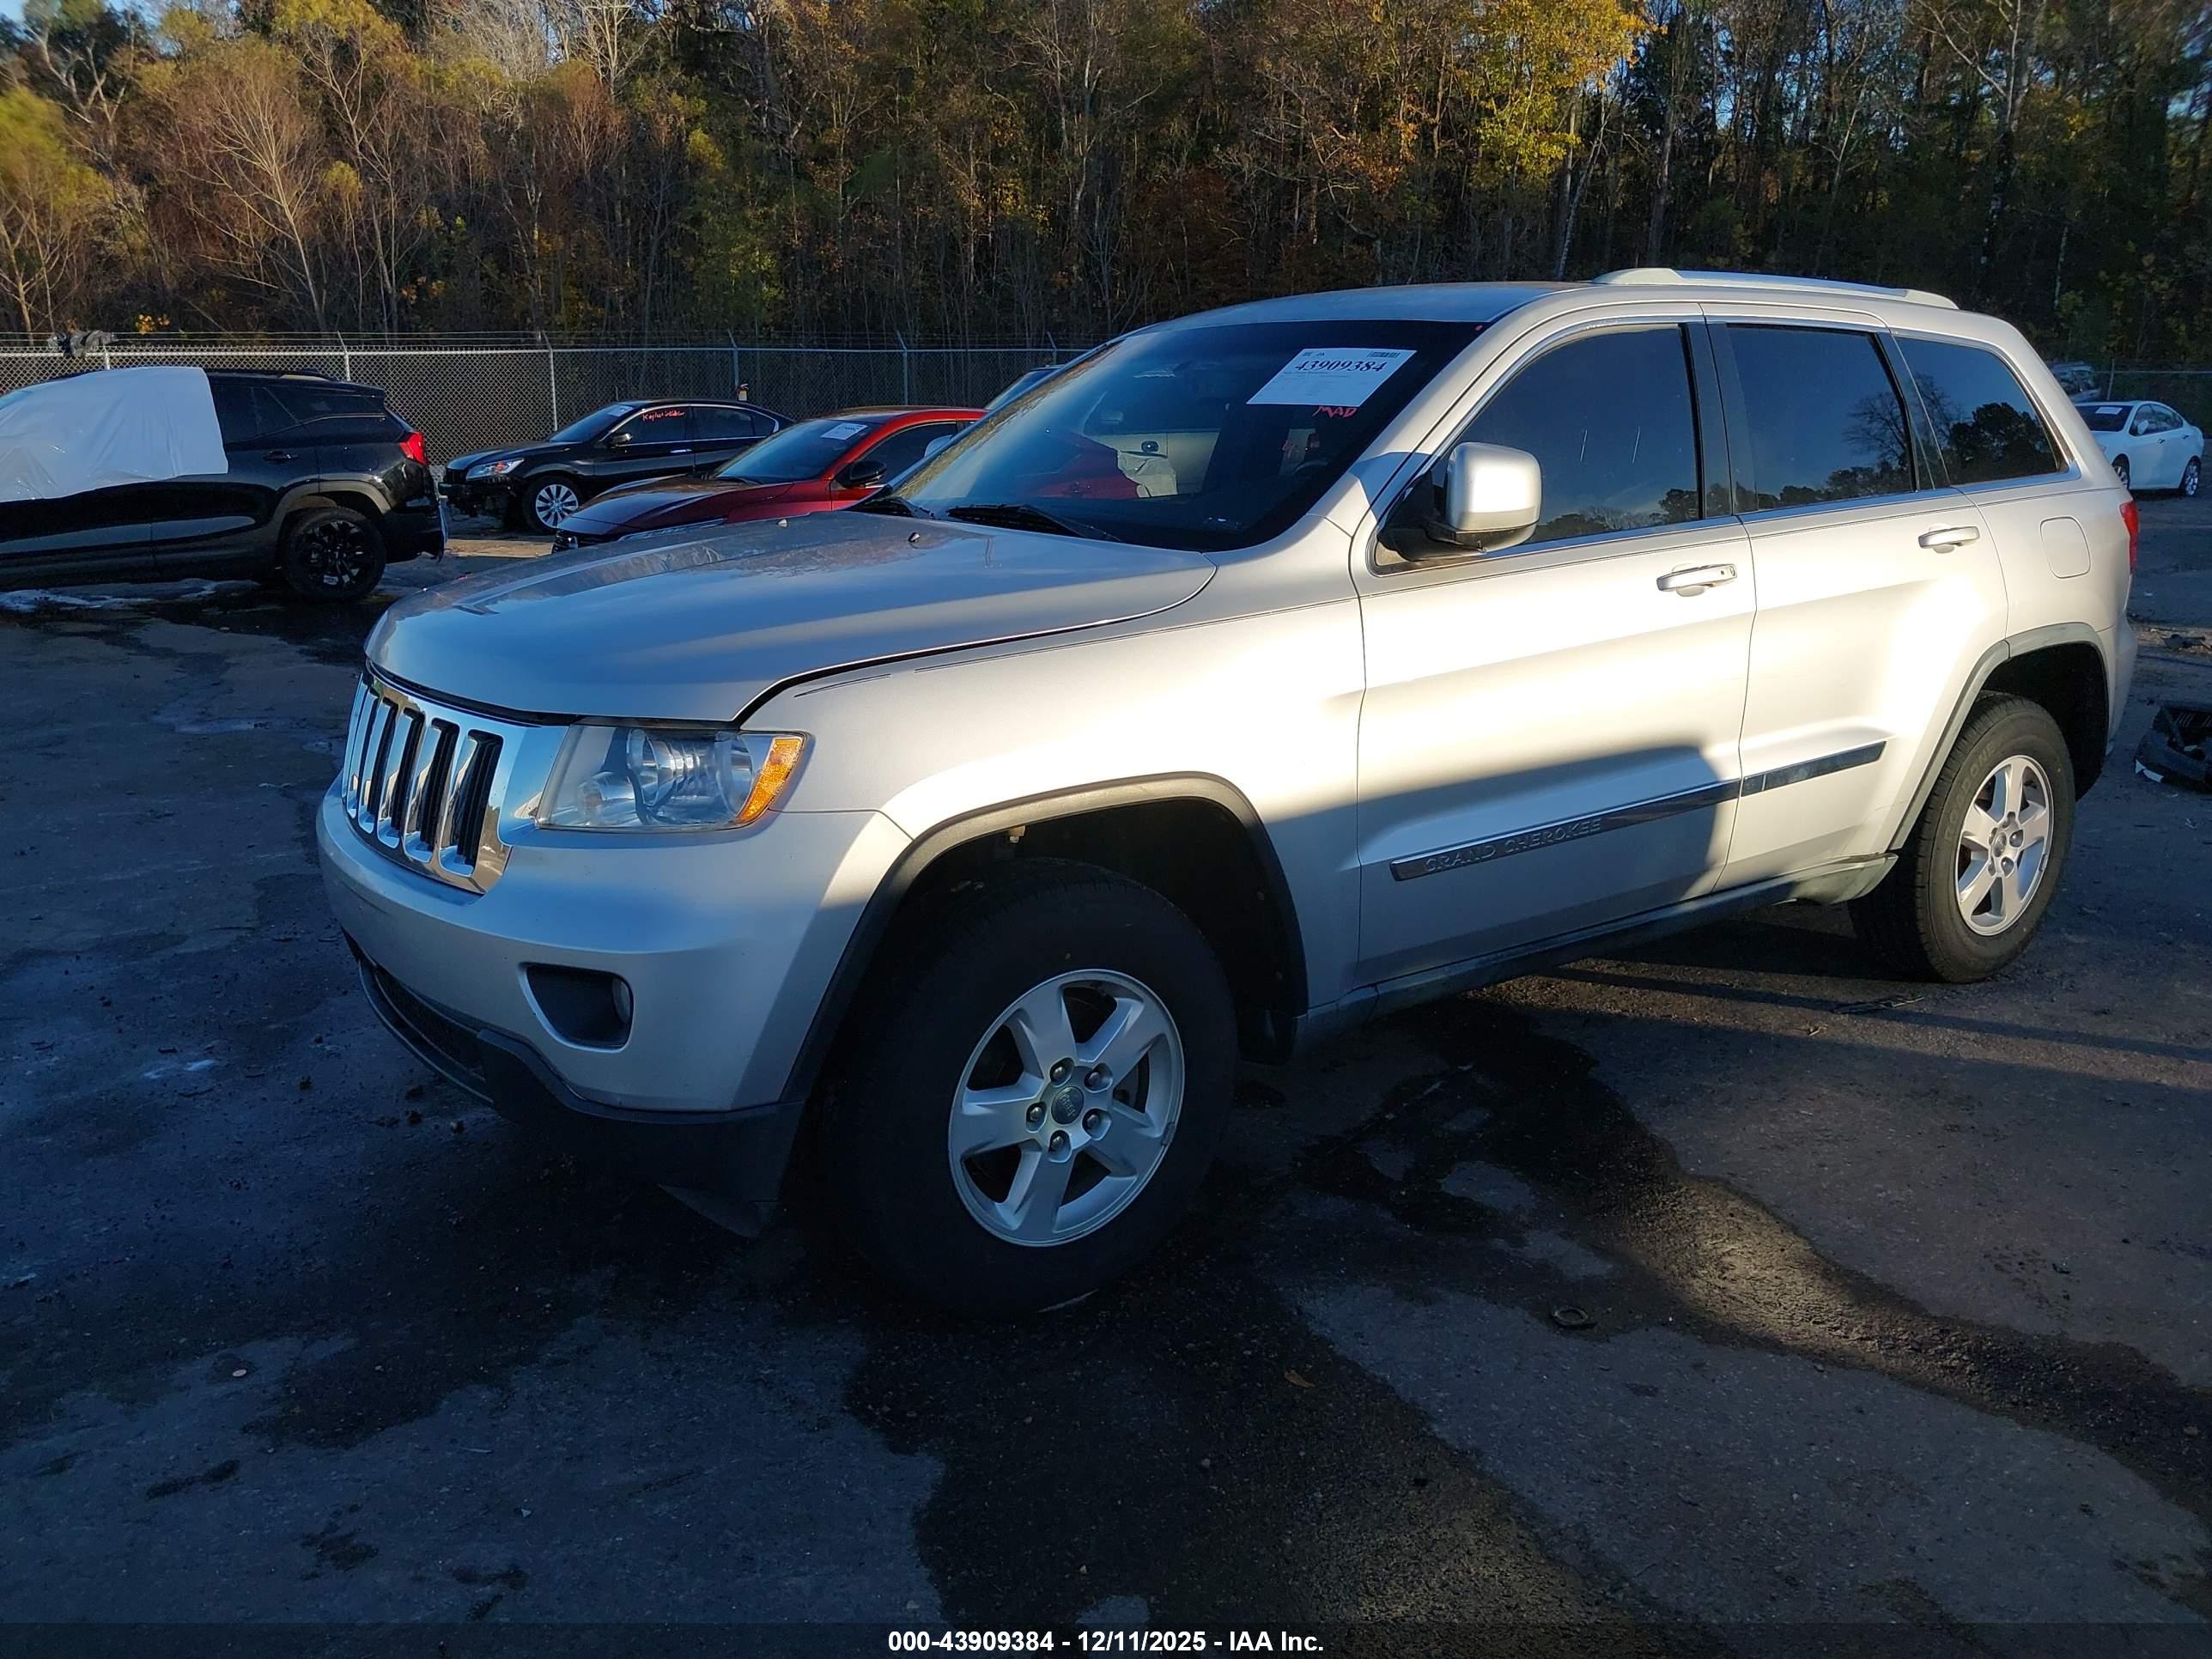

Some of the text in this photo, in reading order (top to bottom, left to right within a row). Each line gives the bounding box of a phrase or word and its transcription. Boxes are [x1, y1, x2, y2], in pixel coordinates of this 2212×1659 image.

[1295, 360, 1388, 372] 43909384
[1425, 817, 1601, 872] GRAND CHEROKEE
